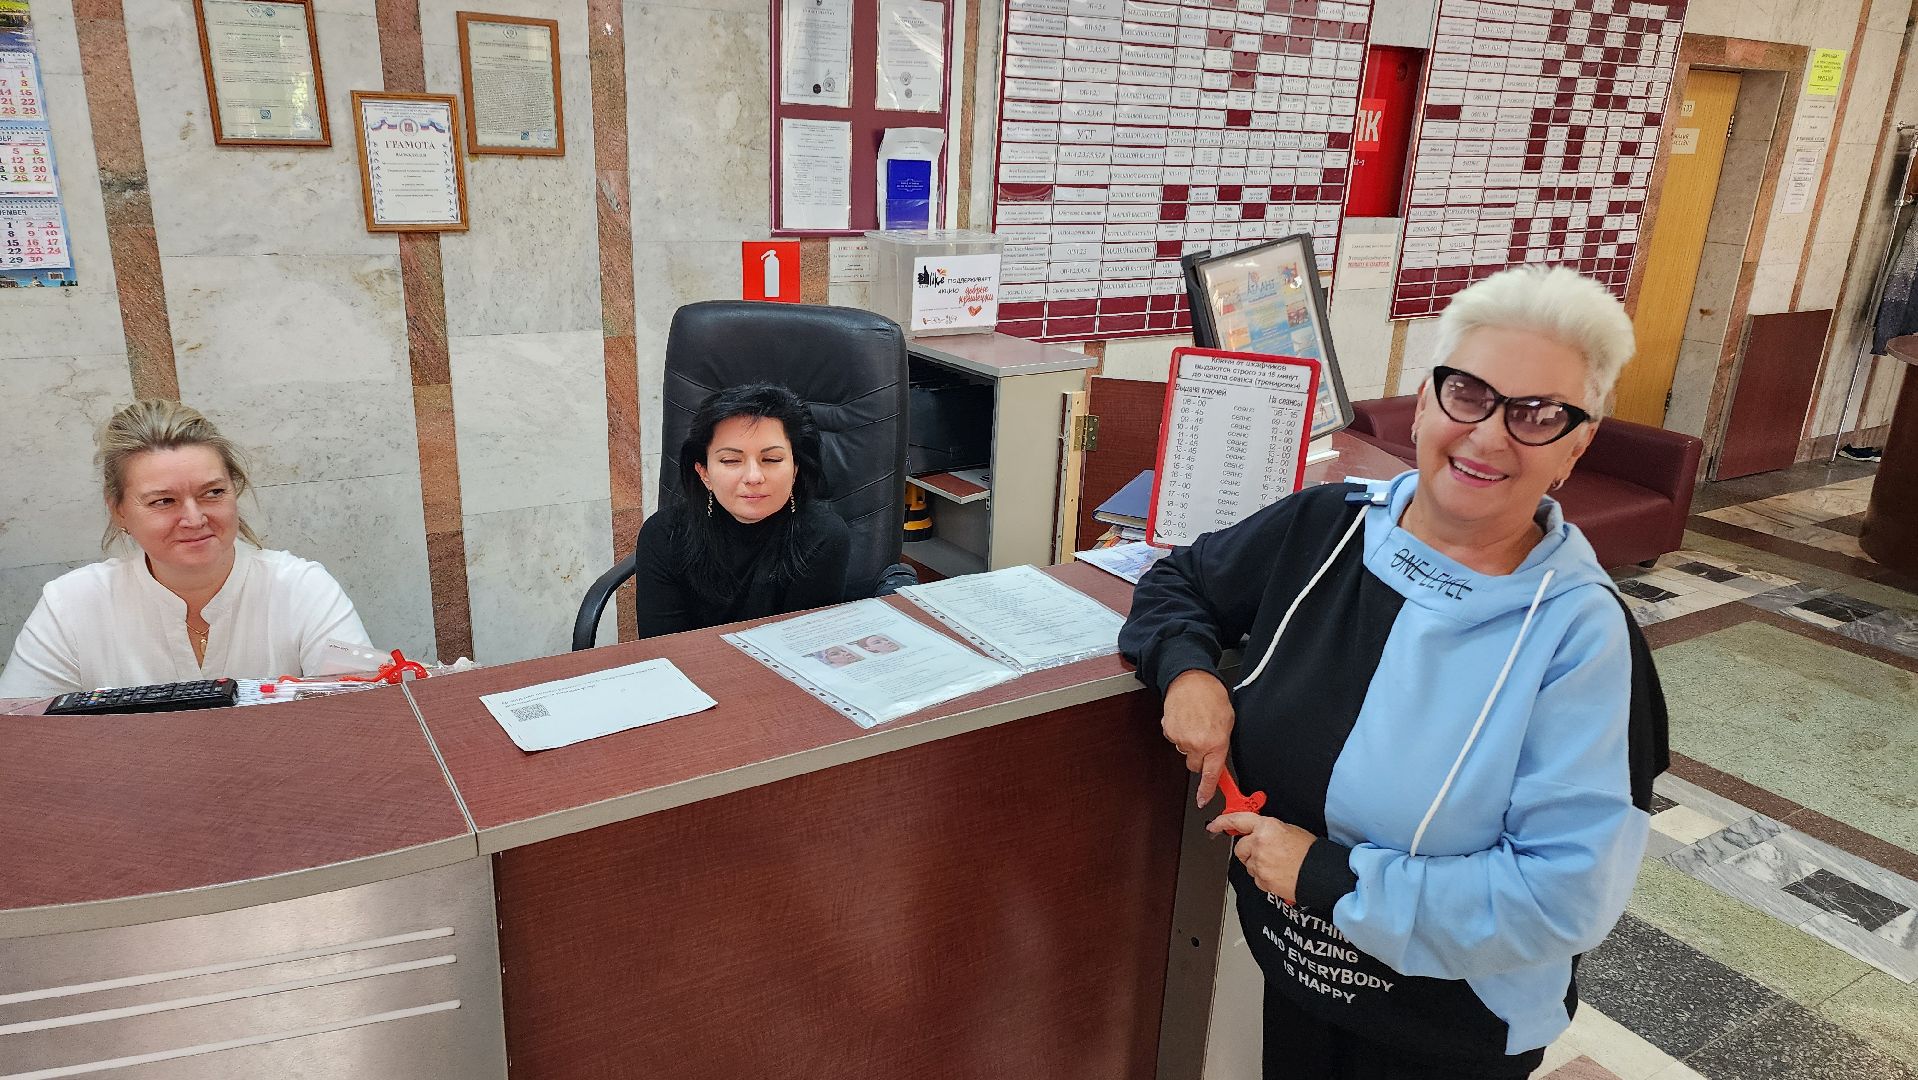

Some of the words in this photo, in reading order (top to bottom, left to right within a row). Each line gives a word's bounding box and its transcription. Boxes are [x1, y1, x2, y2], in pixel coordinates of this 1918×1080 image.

[385, 140, 436, 150] ГРАМОТА
[1194, 363, 1231, 373] выдаются
[1232, 367, 1256, 376] строго
[1277, 373, 1298, 382] минут
[1211, 356, 1234, 366] Ключи
[1201, 386, 1227, 397] ключей
[1391, 548, 1430, 582] ONE
[1267, 892, 1350, 943] EVERYTHIN
[1262, 925, 1285, 952] AND
[1288, 947, 1394, 993] EVERYBODY
[1283, 926, 1359, 964] AMAZING
[1283, 960, 1295, 977] IS
[1298, 971, 1356, 1004] HAPPY
